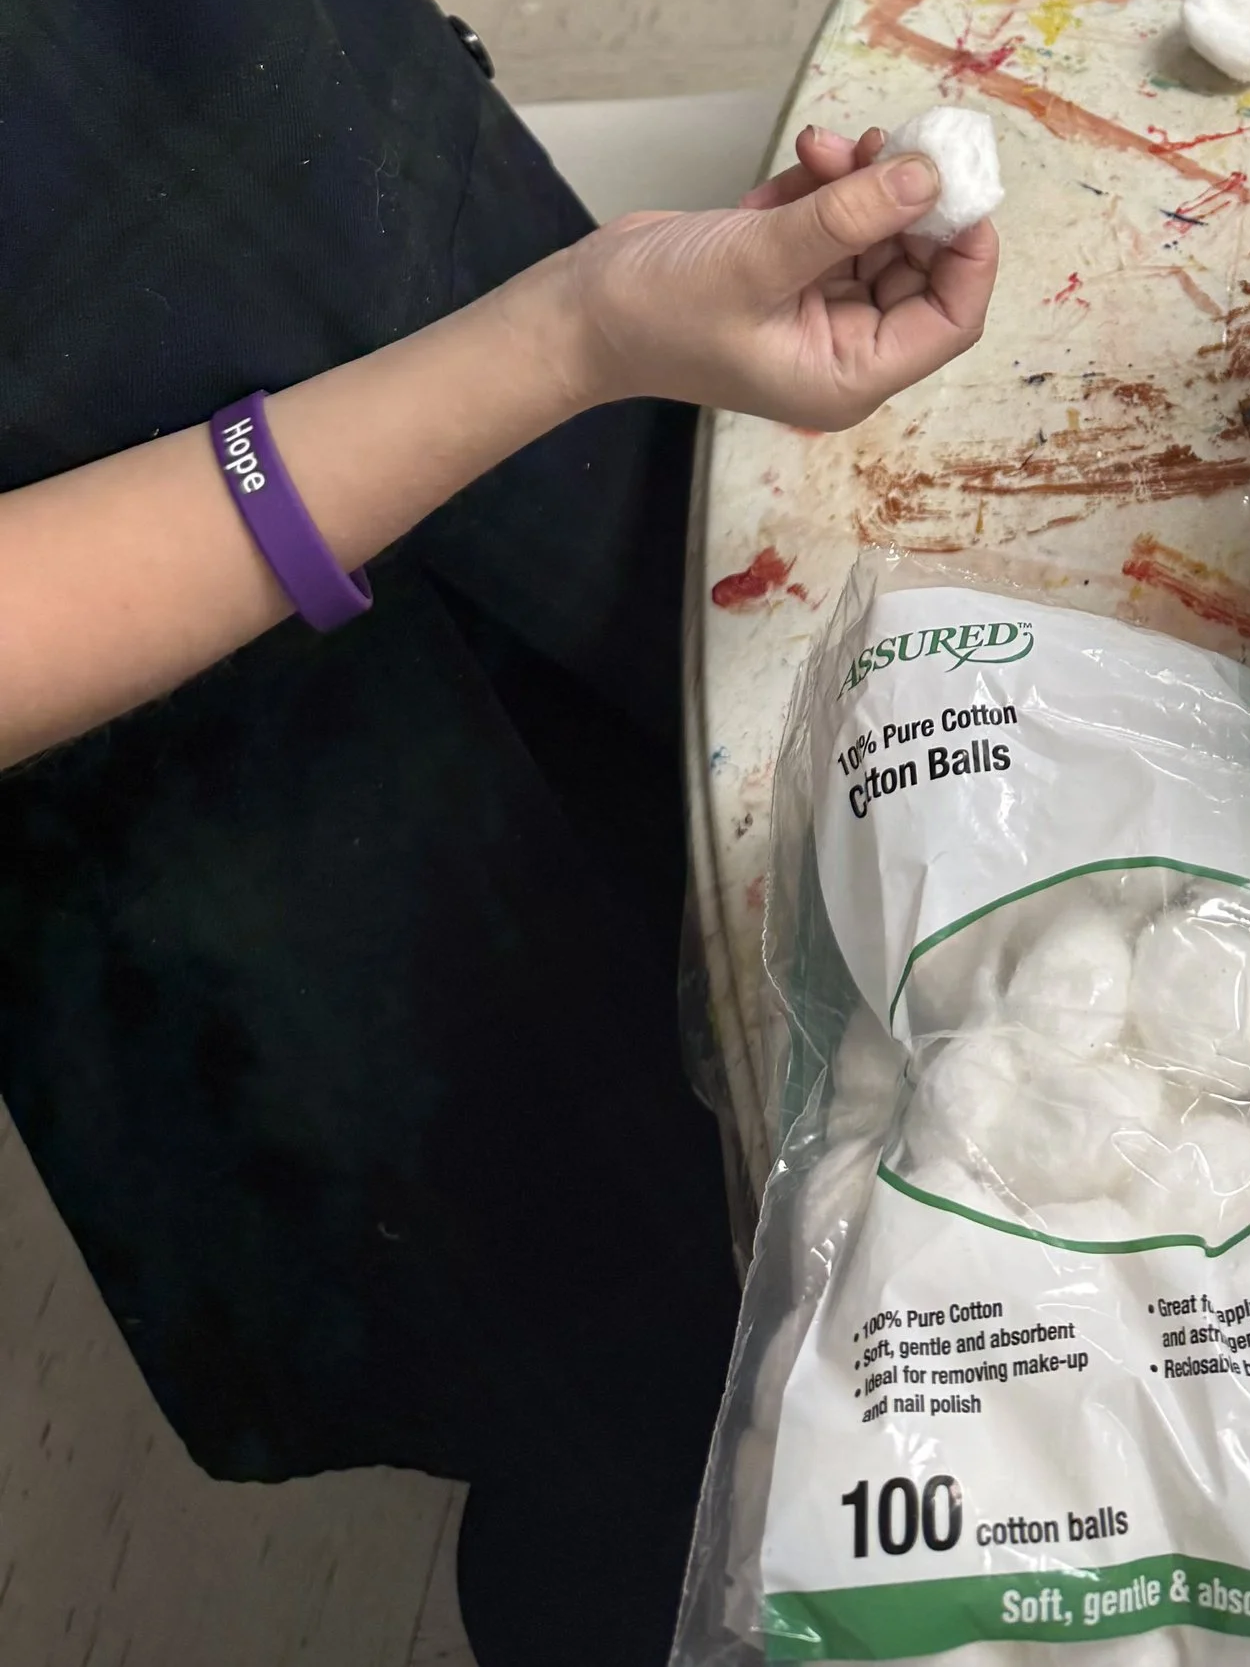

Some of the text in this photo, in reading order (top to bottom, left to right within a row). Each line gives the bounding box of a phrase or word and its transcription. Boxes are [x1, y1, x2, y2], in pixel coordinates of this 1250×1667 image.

[222, 416, 266, 494] Hope
[836, 622, 1034, 701] ASSURED
[837, 704, 1018, 776] 10% Pure Cotton
[849, 739, 1011, 819] Ctton Balls
[862, 1301, 1004, 1339] 100% Pure Cotton
[1157, 1295, 1197, 1317] Great
[899, 1337, 951, 1358] gentle
[956, 1330, 985, 1353] and
[990, 1322, 1076, 1347] absorbent
[1162, 1330, 1186, 1348] and
[864, 1351, 1089, 1396] Ideal for removing make-up
[1164, 1354, 1241, 1379] Reclosable
[861, 1394, 982, 1423] and nail polish
[841, 1474, 1129, 1558] 100 cotton balls
[1002, 1588, 1073, 1626] Soft,
[1083, 1575, 1160, 1625] gentle
[1169, 1569, 1191, 1603] &
